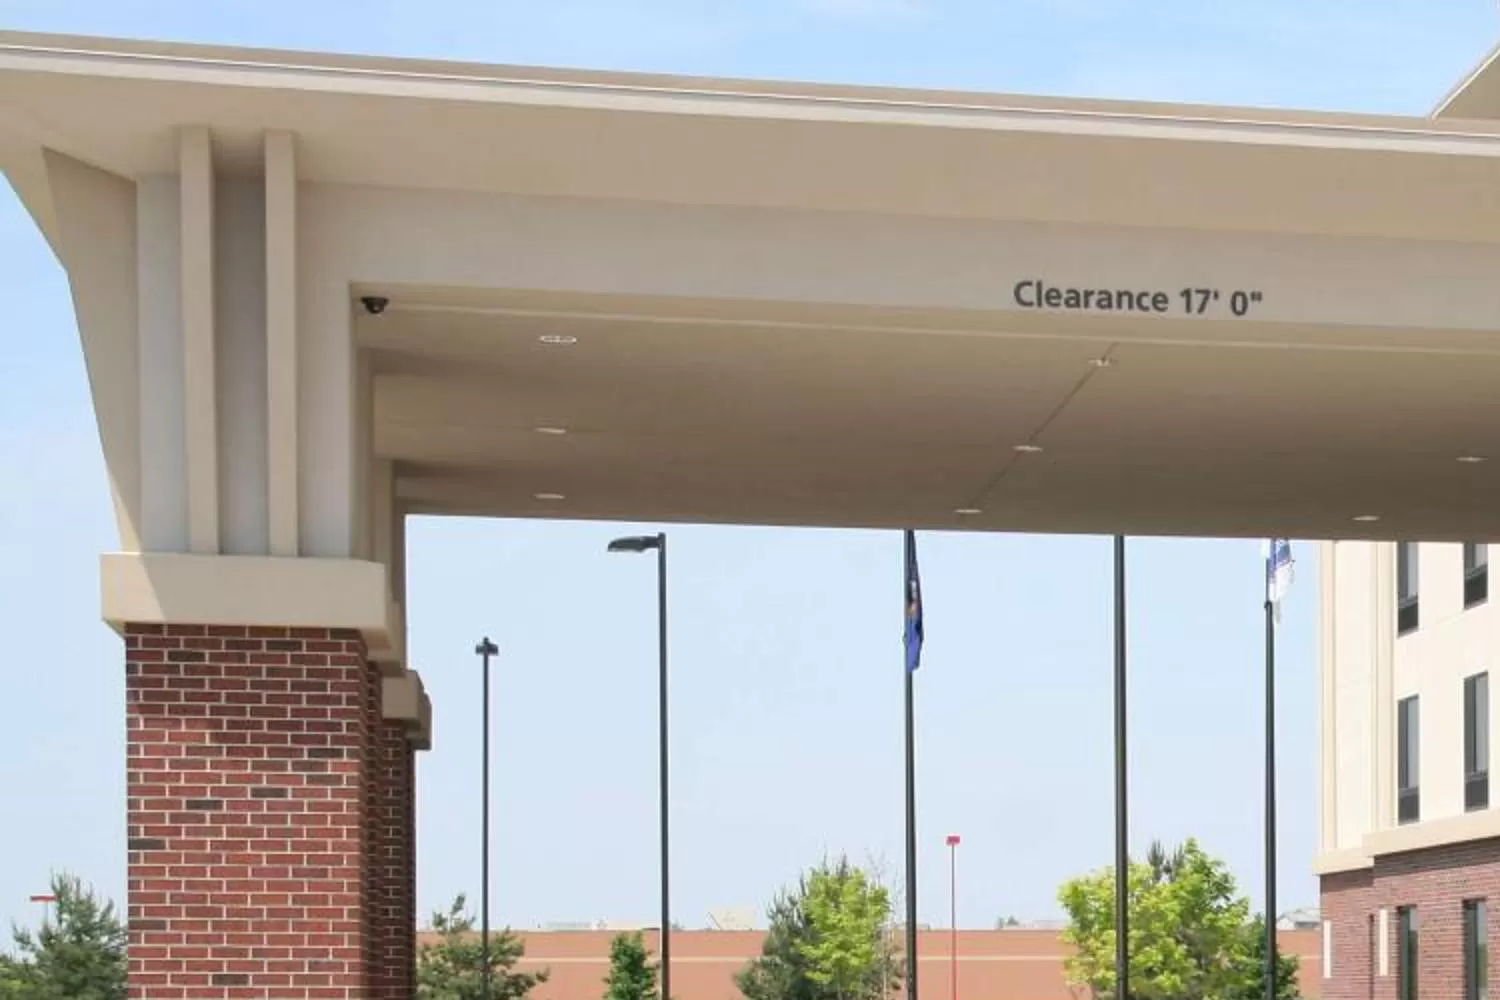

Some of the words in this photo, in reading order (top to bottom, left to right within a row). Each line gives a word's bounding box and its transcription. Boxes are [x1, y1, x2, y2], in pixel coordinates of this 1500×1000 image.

[1013, 280, 1169, 313] Clearance
[1179, 287, 1220, 314] 17'
[1229, 290, 1263, 317] 0"
